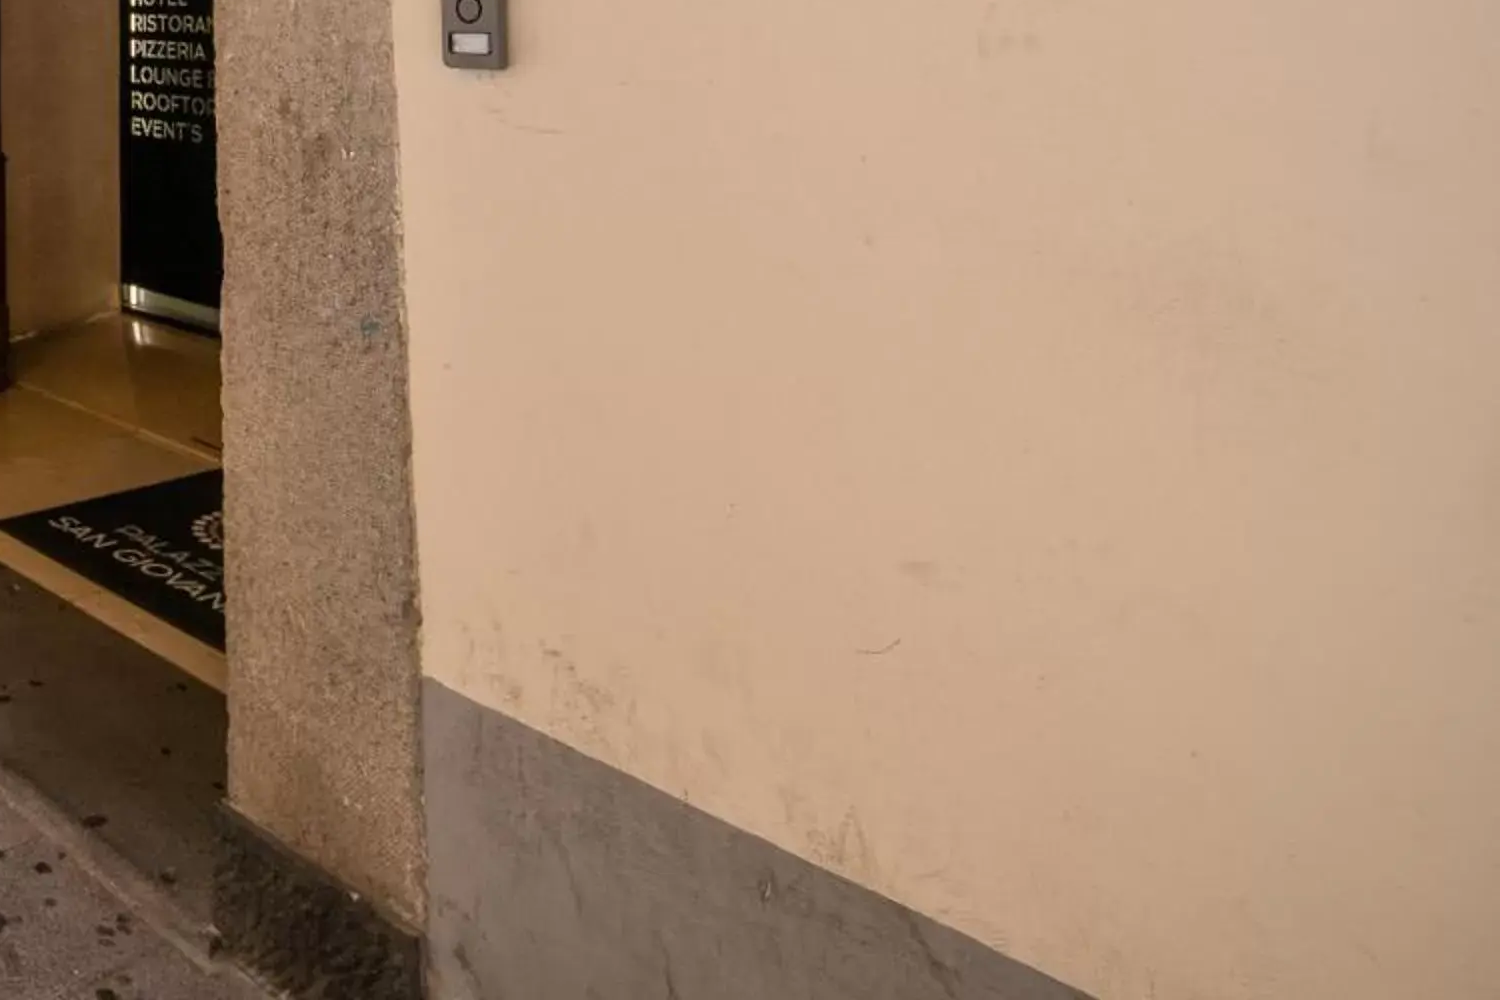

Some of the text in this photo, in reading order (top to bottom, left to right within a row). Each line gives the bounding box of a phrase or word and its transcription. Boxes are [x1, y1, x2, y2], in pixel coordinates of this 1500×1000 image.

[130, 39, 206, 60] PIZZERIA
[130, 64, 203, 89] LOUNGE
[131, 115, 203, 143] EVENT'S
[48, 516, 119, 549] SAN
